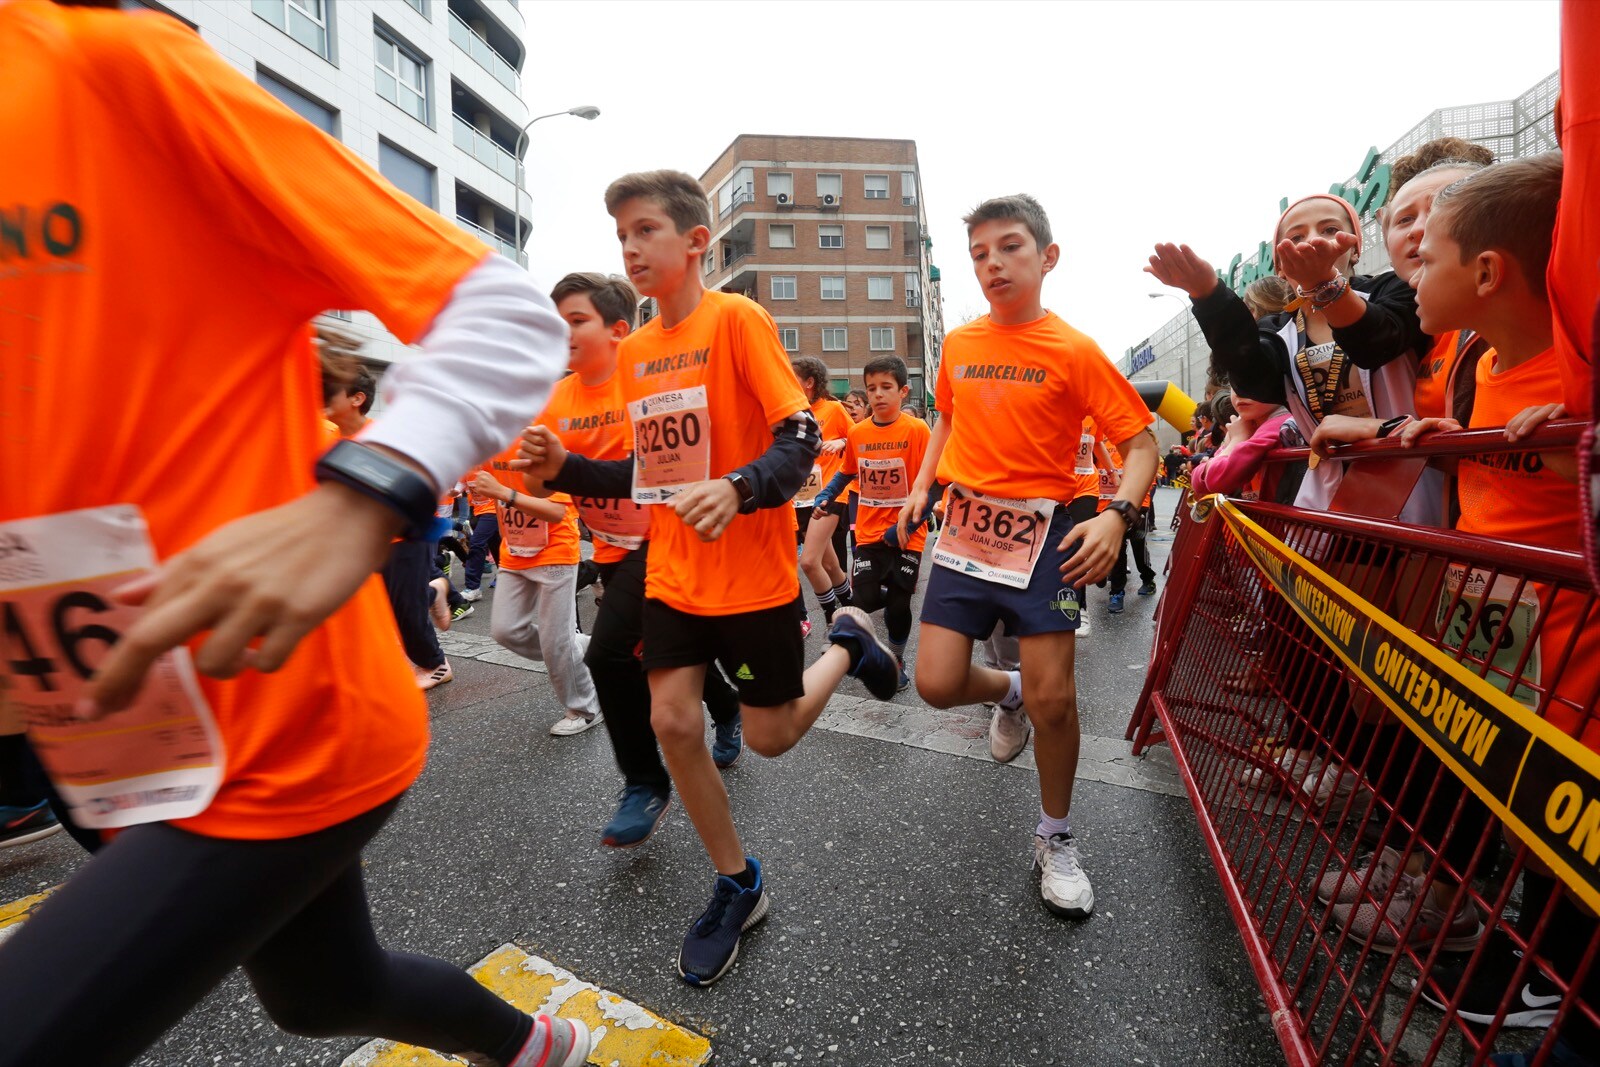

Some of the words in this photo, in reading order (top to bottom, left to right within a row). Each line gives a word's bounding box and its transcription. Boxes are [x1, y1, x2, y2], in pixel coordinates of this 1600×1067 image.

[1307, 344, 1335, 357] OXIM
[964, 365, 1047, 384] MARCELINO
[1337, 390, 1365, 404] ORIA
[640, 413, 701, 454] 3260
[657, 452, 681, 464] JULIAN
[861, 469, 900, 484] 1475
[958, 500, 1036, 545] 1362
[969, 533, 990, 546] JUAN
[991, 539, 1014, 552] JOSE
[1295, 574, 1356, 647] MARCELINO
[1374, 641, 1501, 767] MARCELINO
